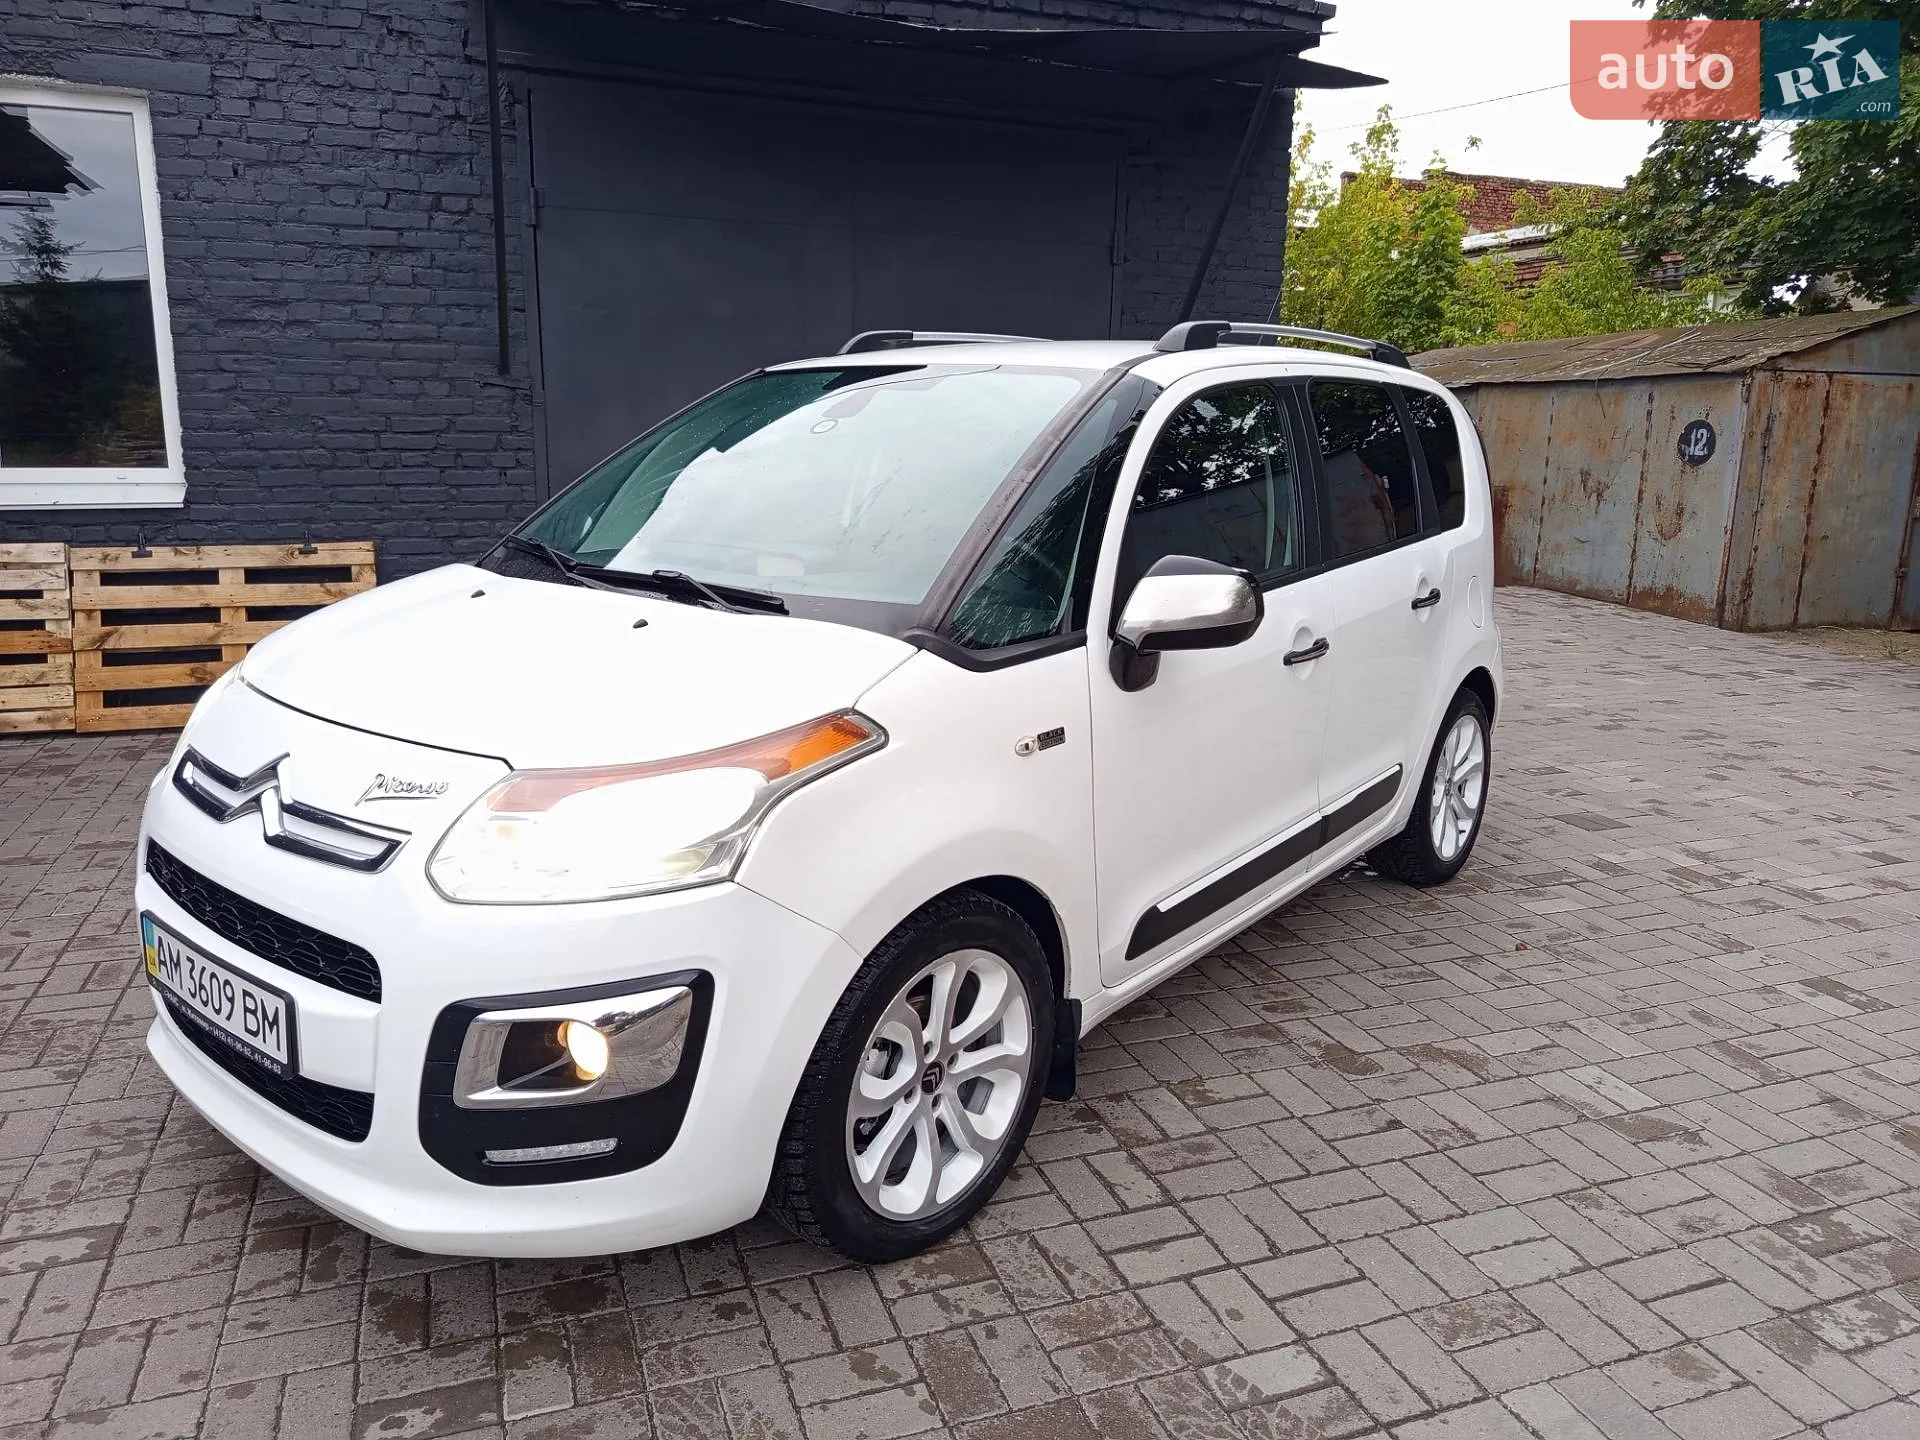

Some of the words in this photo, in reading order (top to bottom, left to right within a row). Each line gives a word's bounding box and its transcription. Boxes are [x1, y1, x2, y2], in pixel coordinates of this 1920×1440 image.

[1689, 428, 1708, 456] 12
[157, 935, 184, 991] AM
[186, 955, 236, 1022] 3609
[242, 988, 281, 1053] BM
